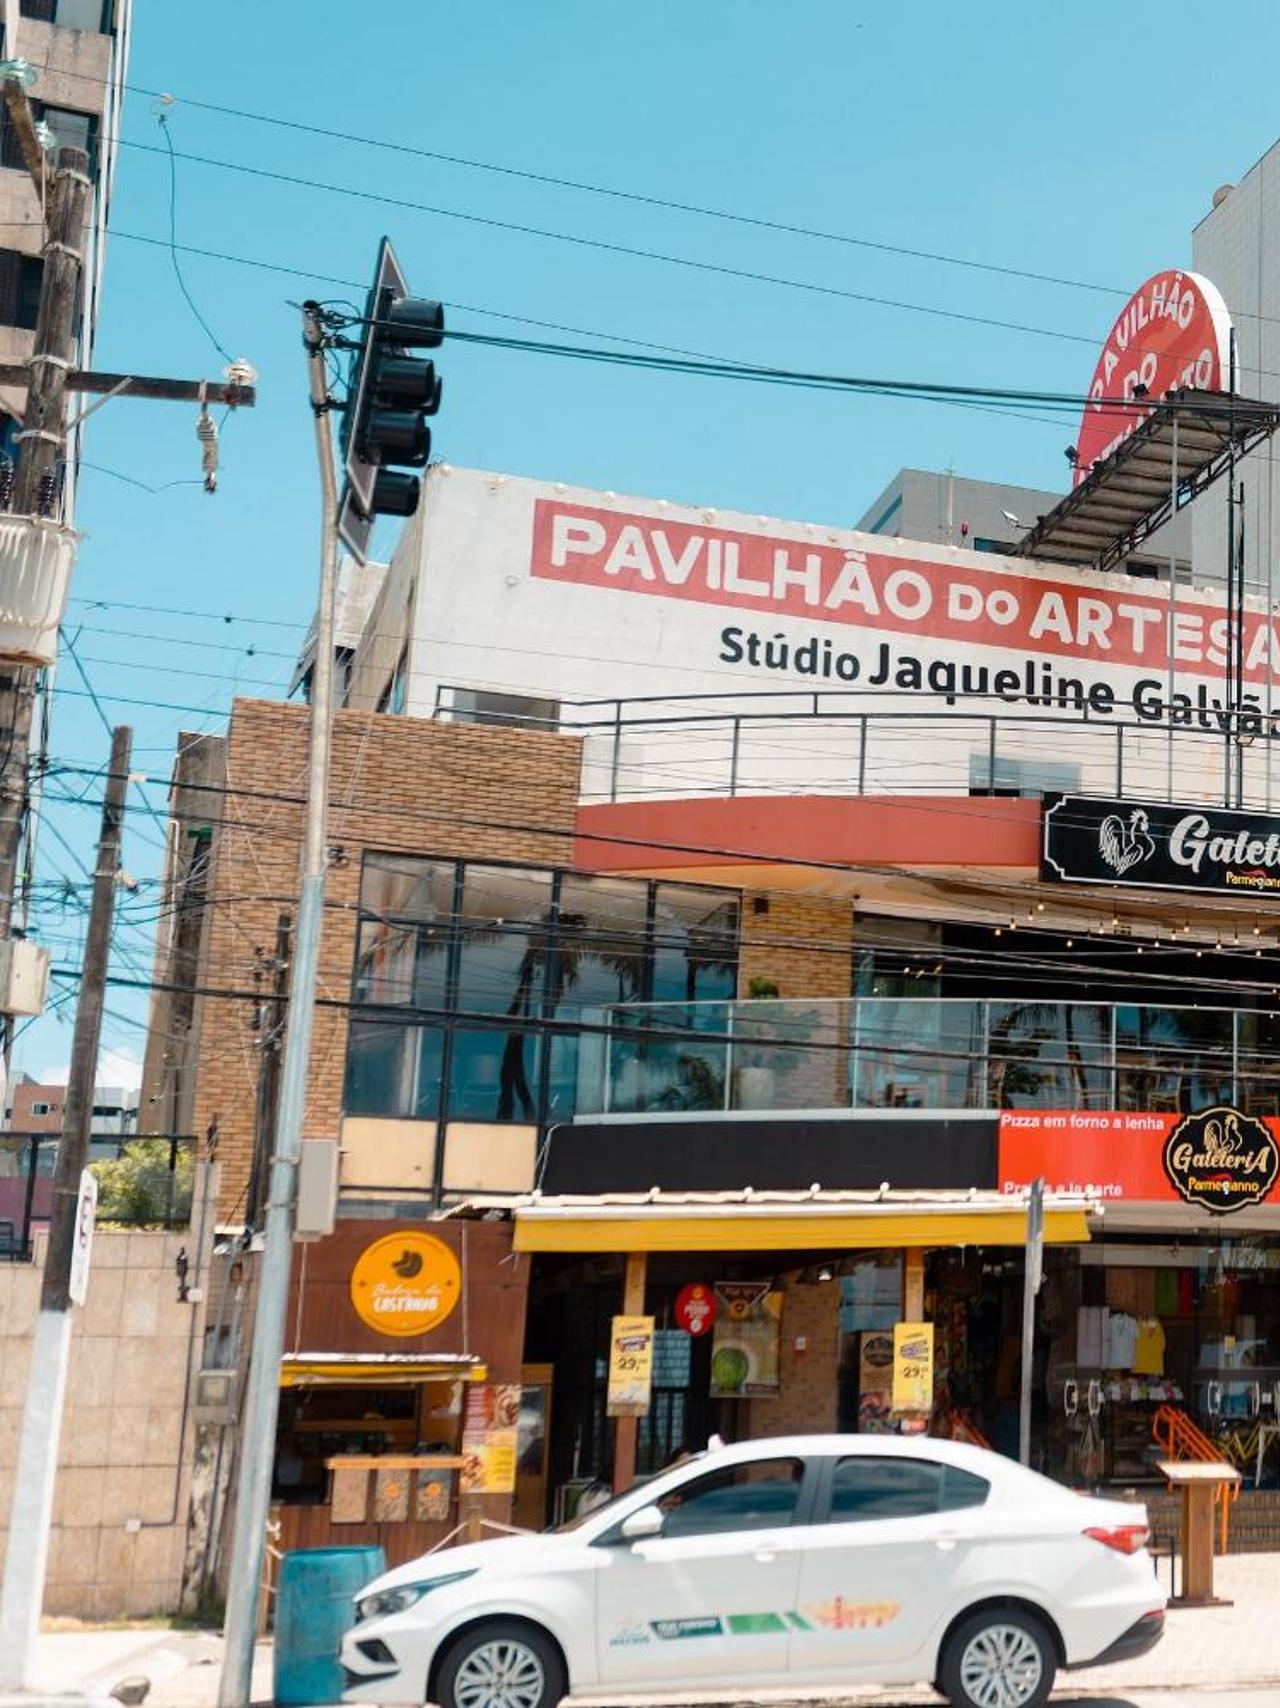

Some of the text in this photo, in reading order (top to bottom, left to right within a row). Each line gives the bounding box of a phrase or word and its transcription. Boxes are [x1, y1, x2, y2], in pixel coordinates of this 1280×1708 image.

[550, 513, 932, 621] PAVILHÃO
[947, 586, 1020, 627] DO
[719, 627, 861, 681] Stúdio
[868, 642, 1115, 715] Jaqueline
[1001, 1114, 1165, 1131] Pizza em forno a lenha
[1004, 1181, 1052, 1196] Pras
[1084, 1183, 1122, 1197] arte
